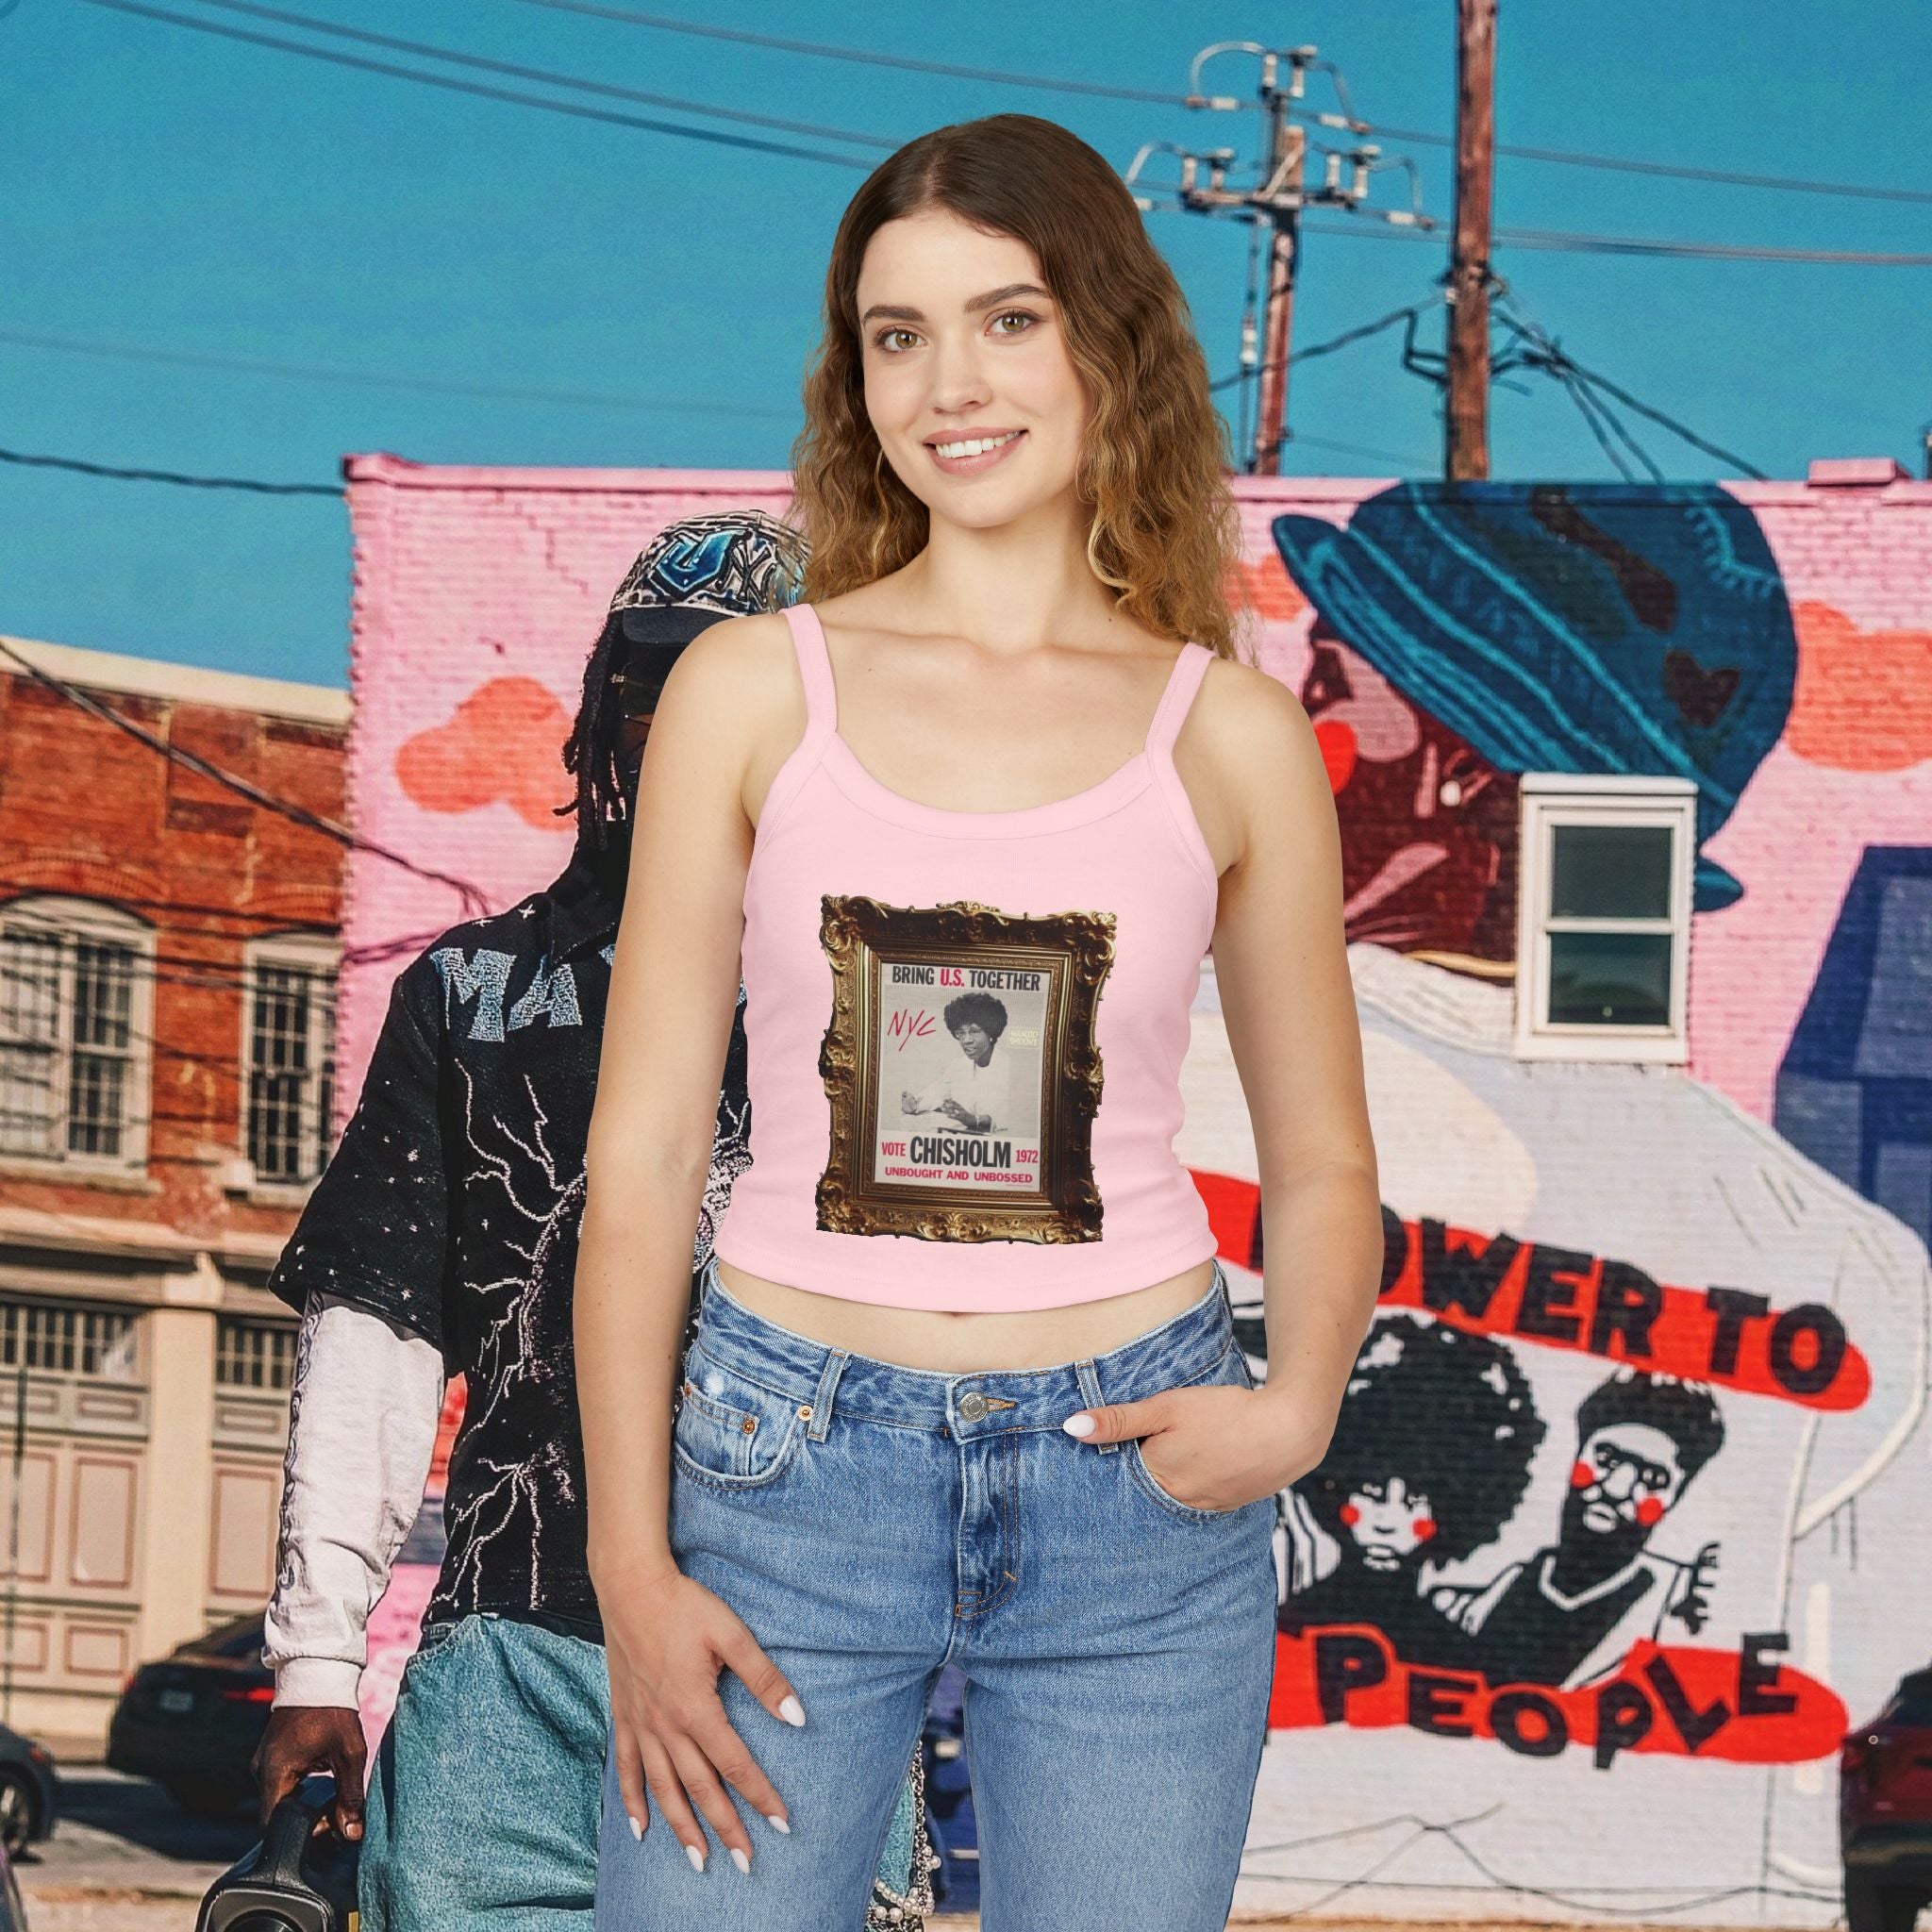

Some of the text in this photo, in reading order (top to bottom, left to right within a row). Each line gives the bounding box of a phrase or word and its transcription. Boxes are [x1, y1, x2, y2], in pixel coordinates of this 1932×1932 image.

[891, 965, 1041, 991] BRING U.S. TOGETHER
[887, 1008, 937, 1052] NYC
[881, 1135, 1039, 1169] VOTE CHISHOLM 1972
[884, 1166, 1033, 1184] UNBOUGHT AND UNBOSSED
[1706, 1287, 1848, 1396] TO
[1315, 1631, 1800, 1771] PEOPLE
